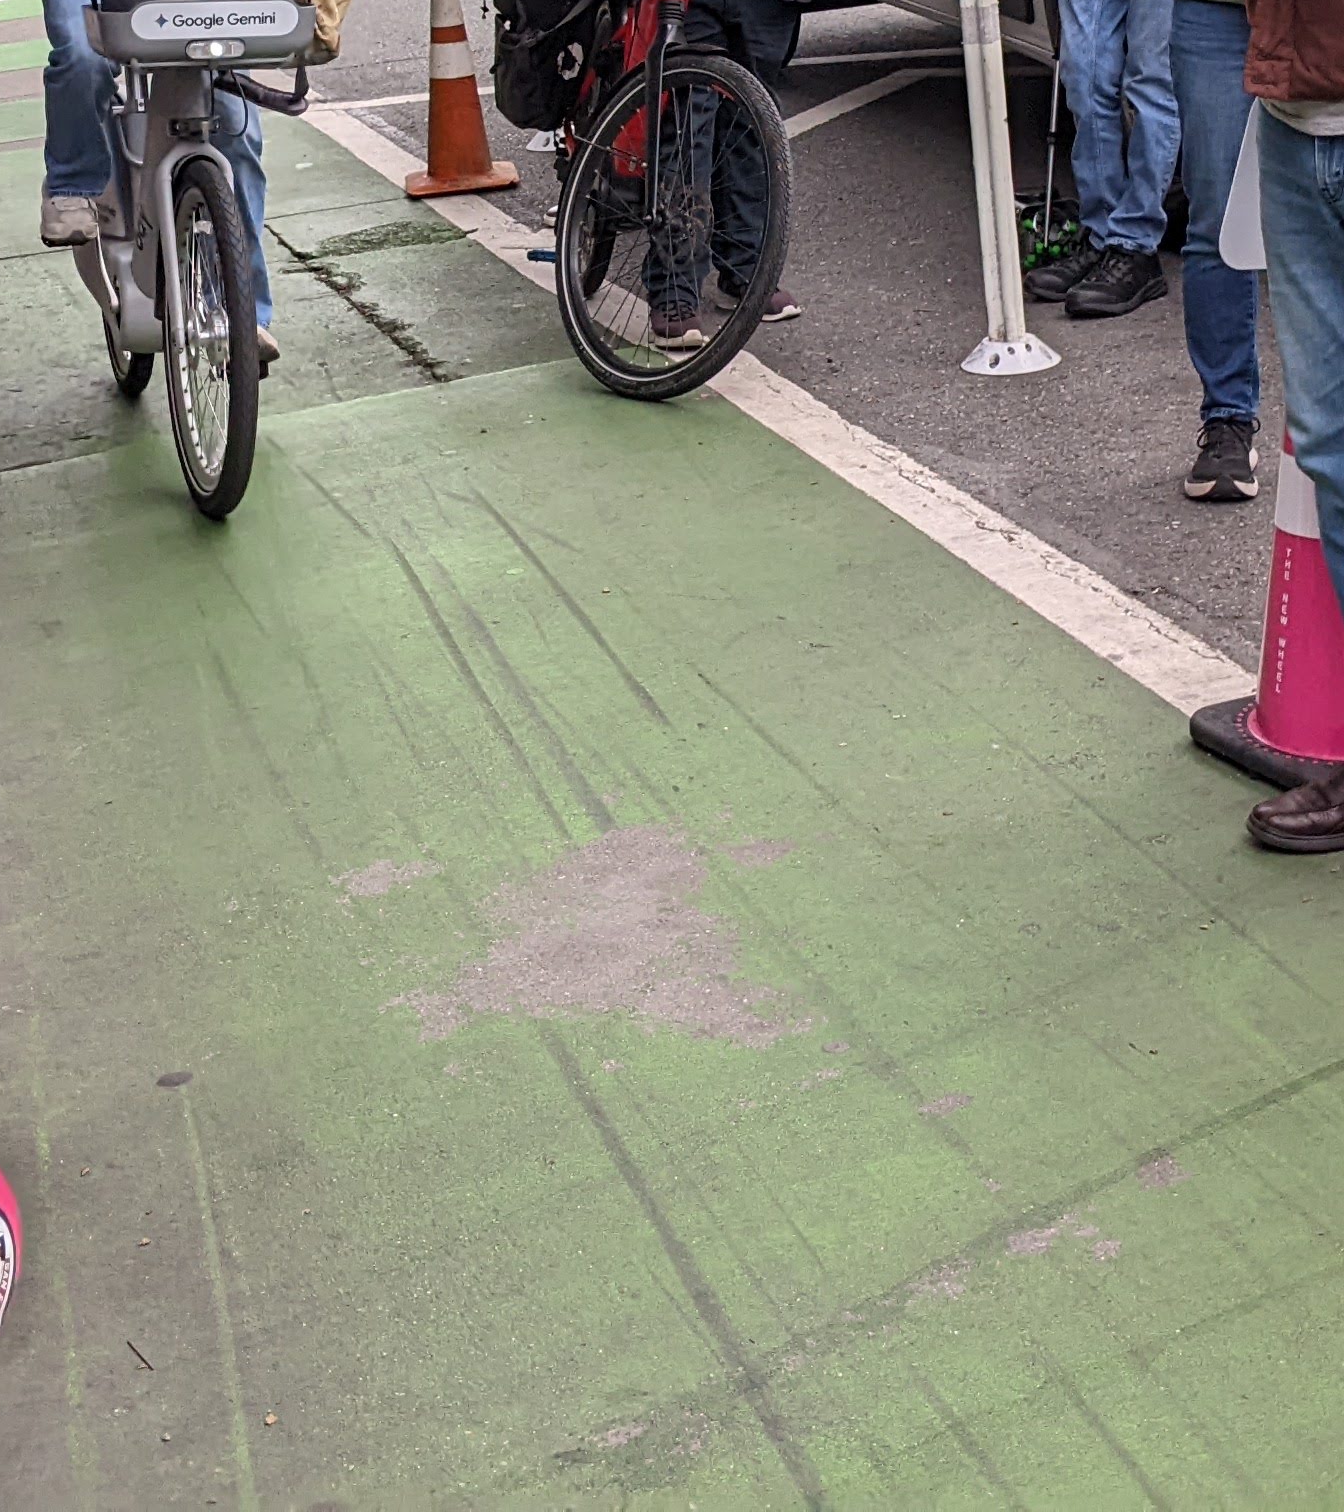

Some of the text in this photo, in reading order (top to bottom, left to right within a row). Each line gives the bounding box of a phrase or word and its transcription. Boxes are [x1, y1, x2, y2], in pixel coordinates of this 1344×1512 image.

[172, 12, 276, 29] Google Gemini
[1275, 548, 1292, 694] THE NEW WHEEL
[0, 1261, 11, 1292] SAN
